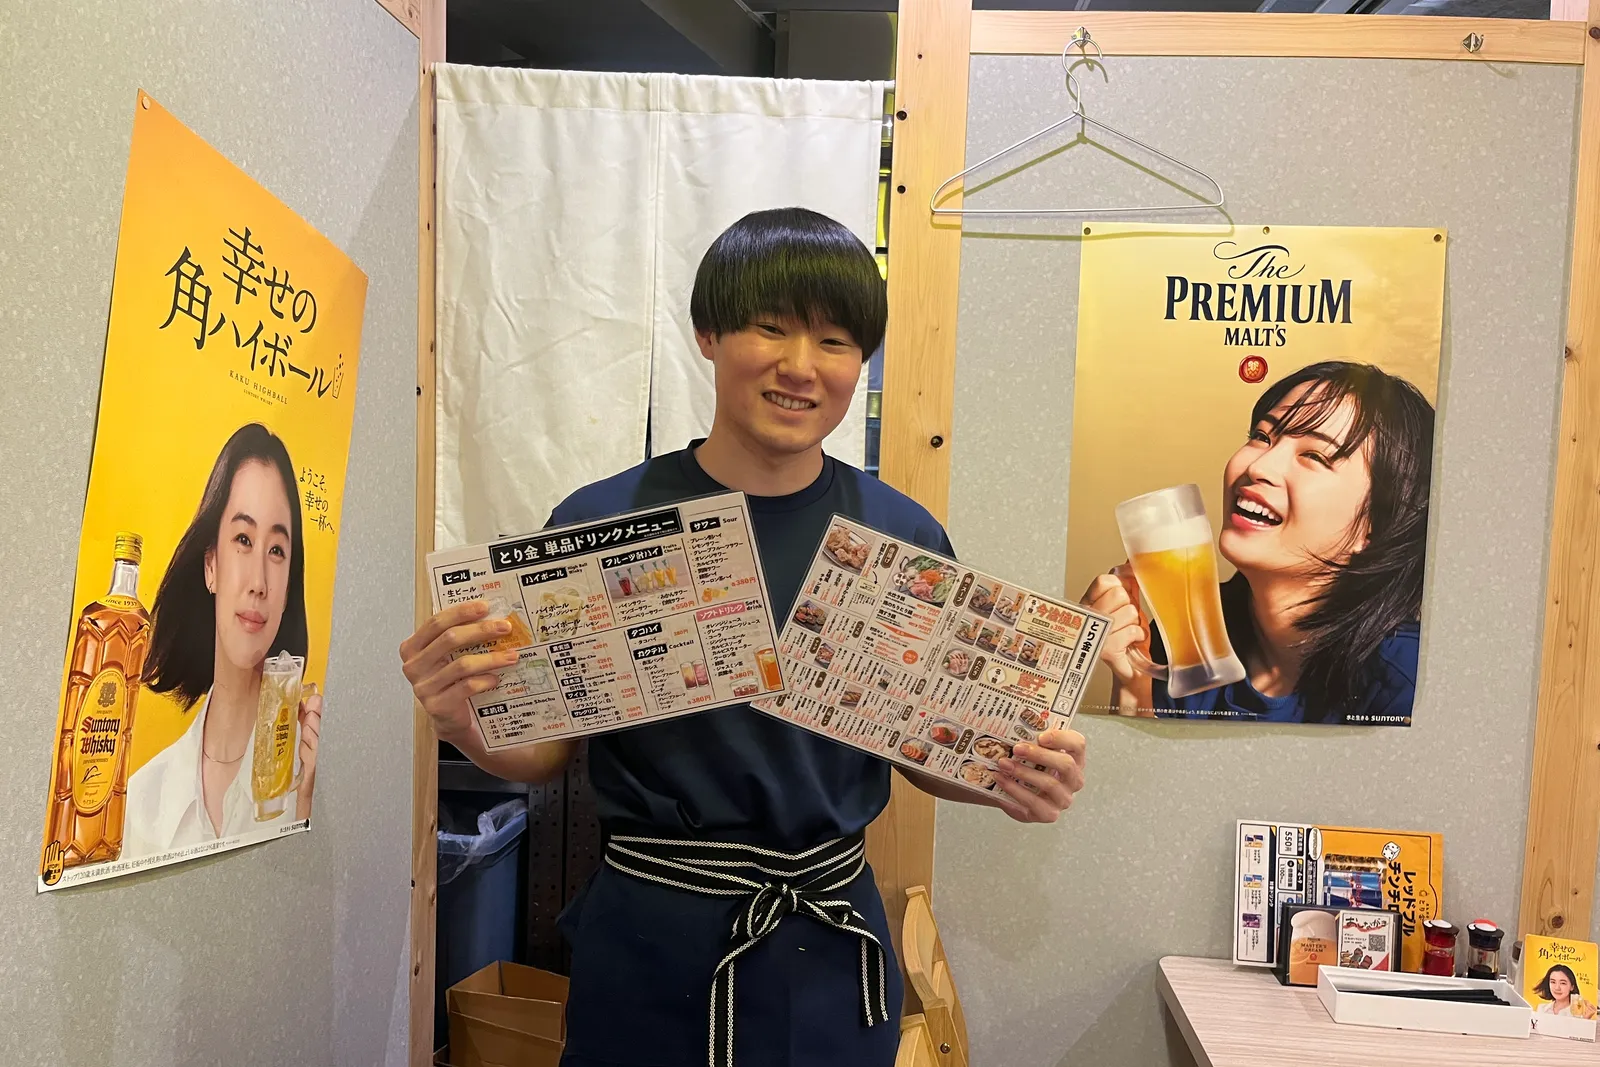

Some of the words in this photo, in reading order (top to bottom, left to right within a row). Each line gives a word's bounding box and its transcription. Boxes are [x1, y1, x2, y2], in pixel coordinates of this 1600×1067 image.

[1214, 241, 1306, 279] The
[222, 227, 316, 333] 幸せの
[1164, 276, 1352, 324] PREMIUM
[159, 246, 332, 398] 角ハイボール
[1224, 324, 1286, 347] MALT'S
[230, 370, 249, 385] KAKU
[254, 382, 287, 404] HIGHBALL
[305, 491, 328, 512] 幸せの
[693, 521, 717, 530] サワー
[500, 544, 540, 565] とり金
[545, 520, 675, 556] 単品ドリンクメニュー
[692, 541, 719, 549] レモンサワー
[605, 547, 659, 567] フルーツ酎ハイ
[695, 552, 726, 561] オレンジサワー
[697, 558, 728, 567] カルピスサワー
[445, 572, 468, 583] ビール
[525, 570, 564, 584] ハイボール
[701, 574, 732, 586] ウーロン茶ハイ
[448, 587, 476, 597] 生ビール
[481, 581, 501, 590] 198円
[660, 589, 688, 599] みかんサワー
[105, 596, 121, 605] since
[588, 594, 604, 603] 55円
[886, 590, 905, 601] 水炊き鍋
[535, 603, 569, 614] ハイボール
[618, 600, 646, 609] パインサワー
[620, 605, 652, 614] マンゴーサワー
[589, 612, 609, 621] 480円
[622, 609, 663, 621] ブルーベリーサワー
[700, 605, 743, 619] ソフトドリンク
[541, 619, 580, 632] 角ハイボール
[706, 618, 741, 629] オレンジジュース
[631, 624, 659, 637] タコハイ
[1080, 620, 1101, 652] とり金
[710, 634, 745, 645] ジンジャーエール
[711, 639, 742, 650] カルピスソーダ
[459, 641, 497, 653] シャンディガフ
[637, 647, 665, 657] カクテル
[669, 640, 694, 649] Cocktail
[712, 644, 752, 656] カルピスウォーター
[714, 652, 736, 660] ウーロン茶
[717, 661, 743, 671] ジャスミン茶
[1015, 670, 1048, 694] 餃子
[509, 701, 533, 710] Jasmine
[574, 708, 597, 717] サングリア
[81, 716, 120, 736] Suntory
[80, 734, 116, 756] Whisky
[1284, 831, 1292, 852] 550円
[1387, 861, 1401, 912] チンチロ
[1403, 872, 1416, 936] レッドブル
[1550, 942, 1575, 954] 幸せの
[1538, 948, 1583, 962] 角ハイボール
